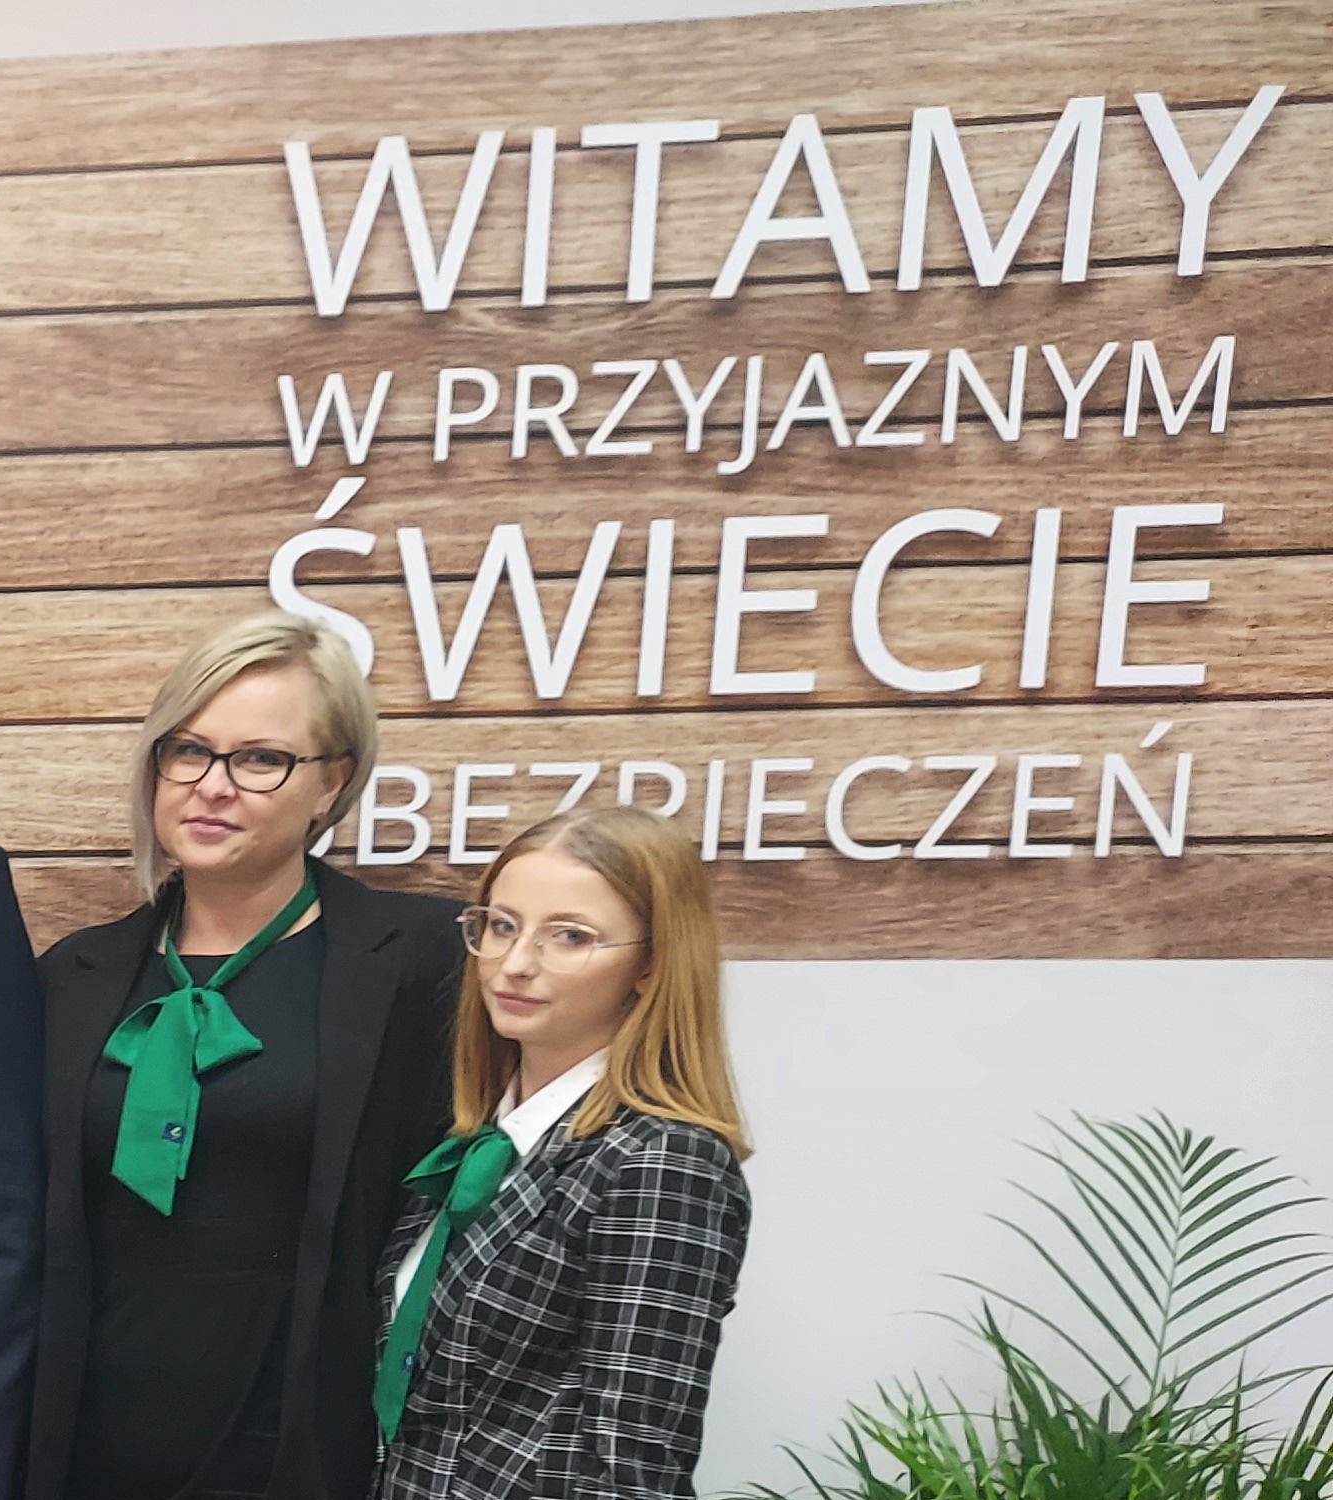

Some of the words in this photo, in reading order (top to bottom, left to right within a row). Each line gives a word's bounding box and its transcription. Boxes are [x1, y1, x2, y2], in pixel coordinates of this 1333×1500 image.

[284, 85, 1287, 317] WITAMY
[278, 371, 393, 467] W
[432, 336, 1237, 475] PRZYJAZNYM
[269, 476, 1225, 701] ŚWIECIE
[308, 723, 1193, 866] BEZPIECZEŃ
